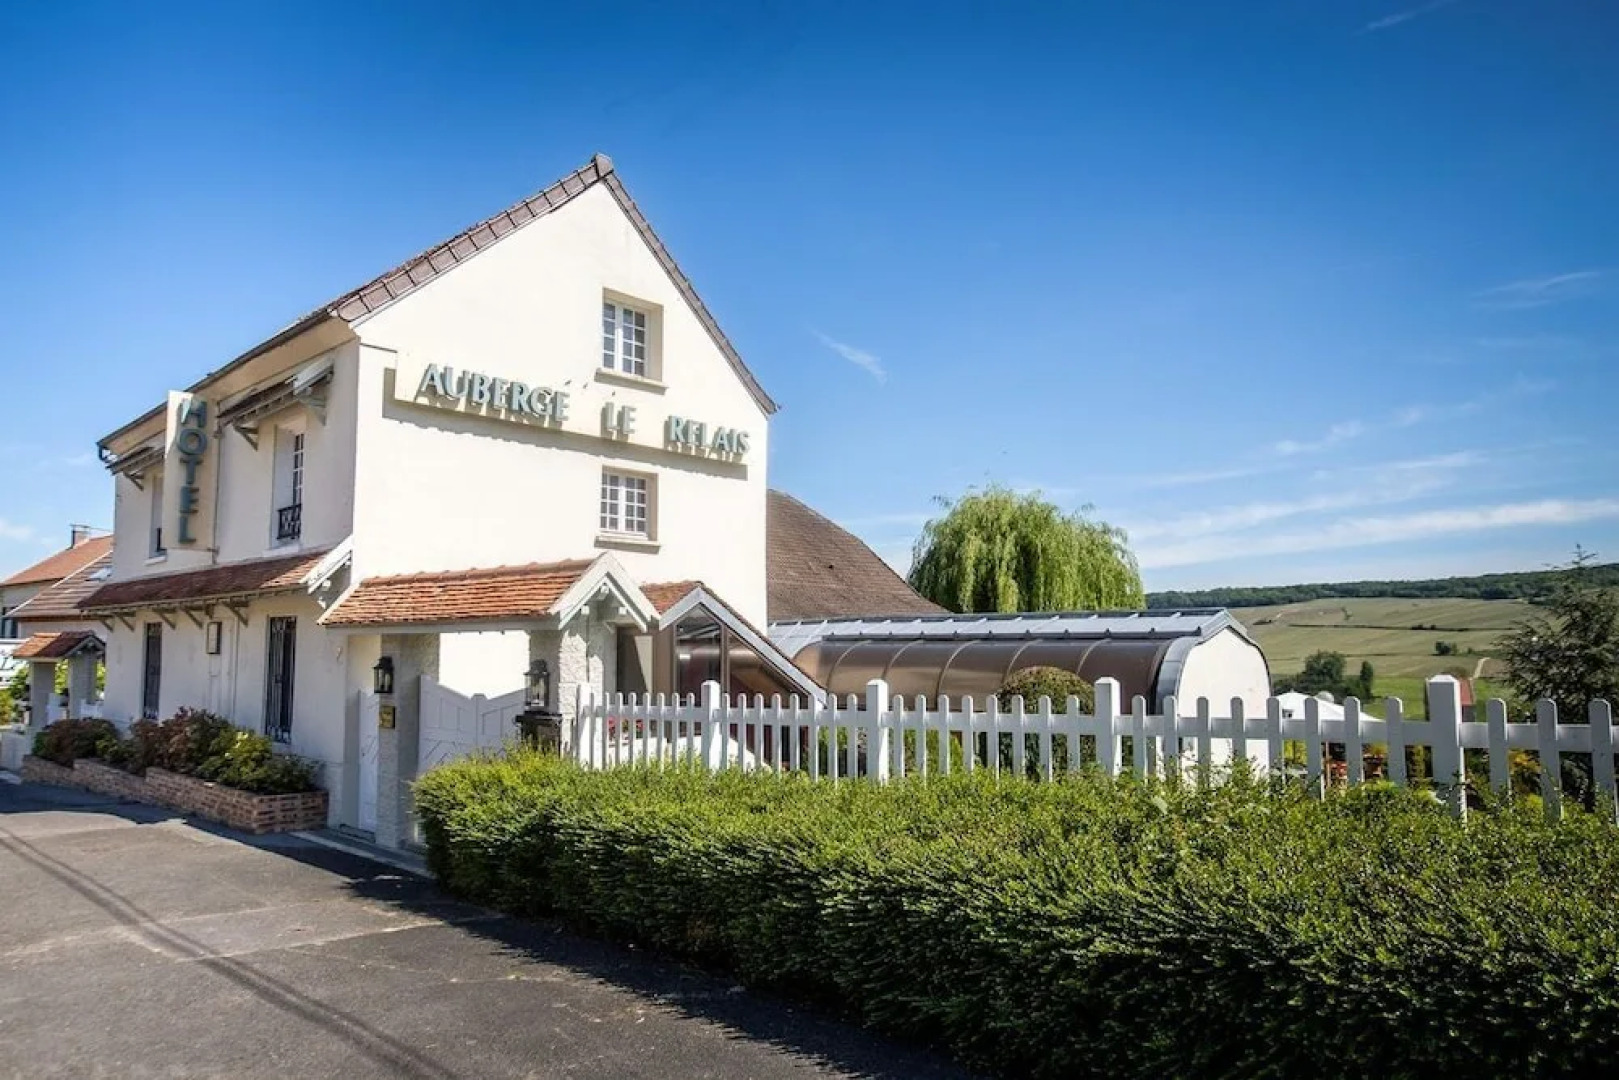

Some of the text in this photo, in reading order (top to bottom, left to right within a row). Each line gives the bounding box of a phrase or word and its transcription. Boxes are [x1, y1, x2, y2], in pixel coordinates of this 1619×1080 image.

[420, 363, 750, 453] AUBERGE LE RELAIS
[178, 399, 208, 543] HOTEL
